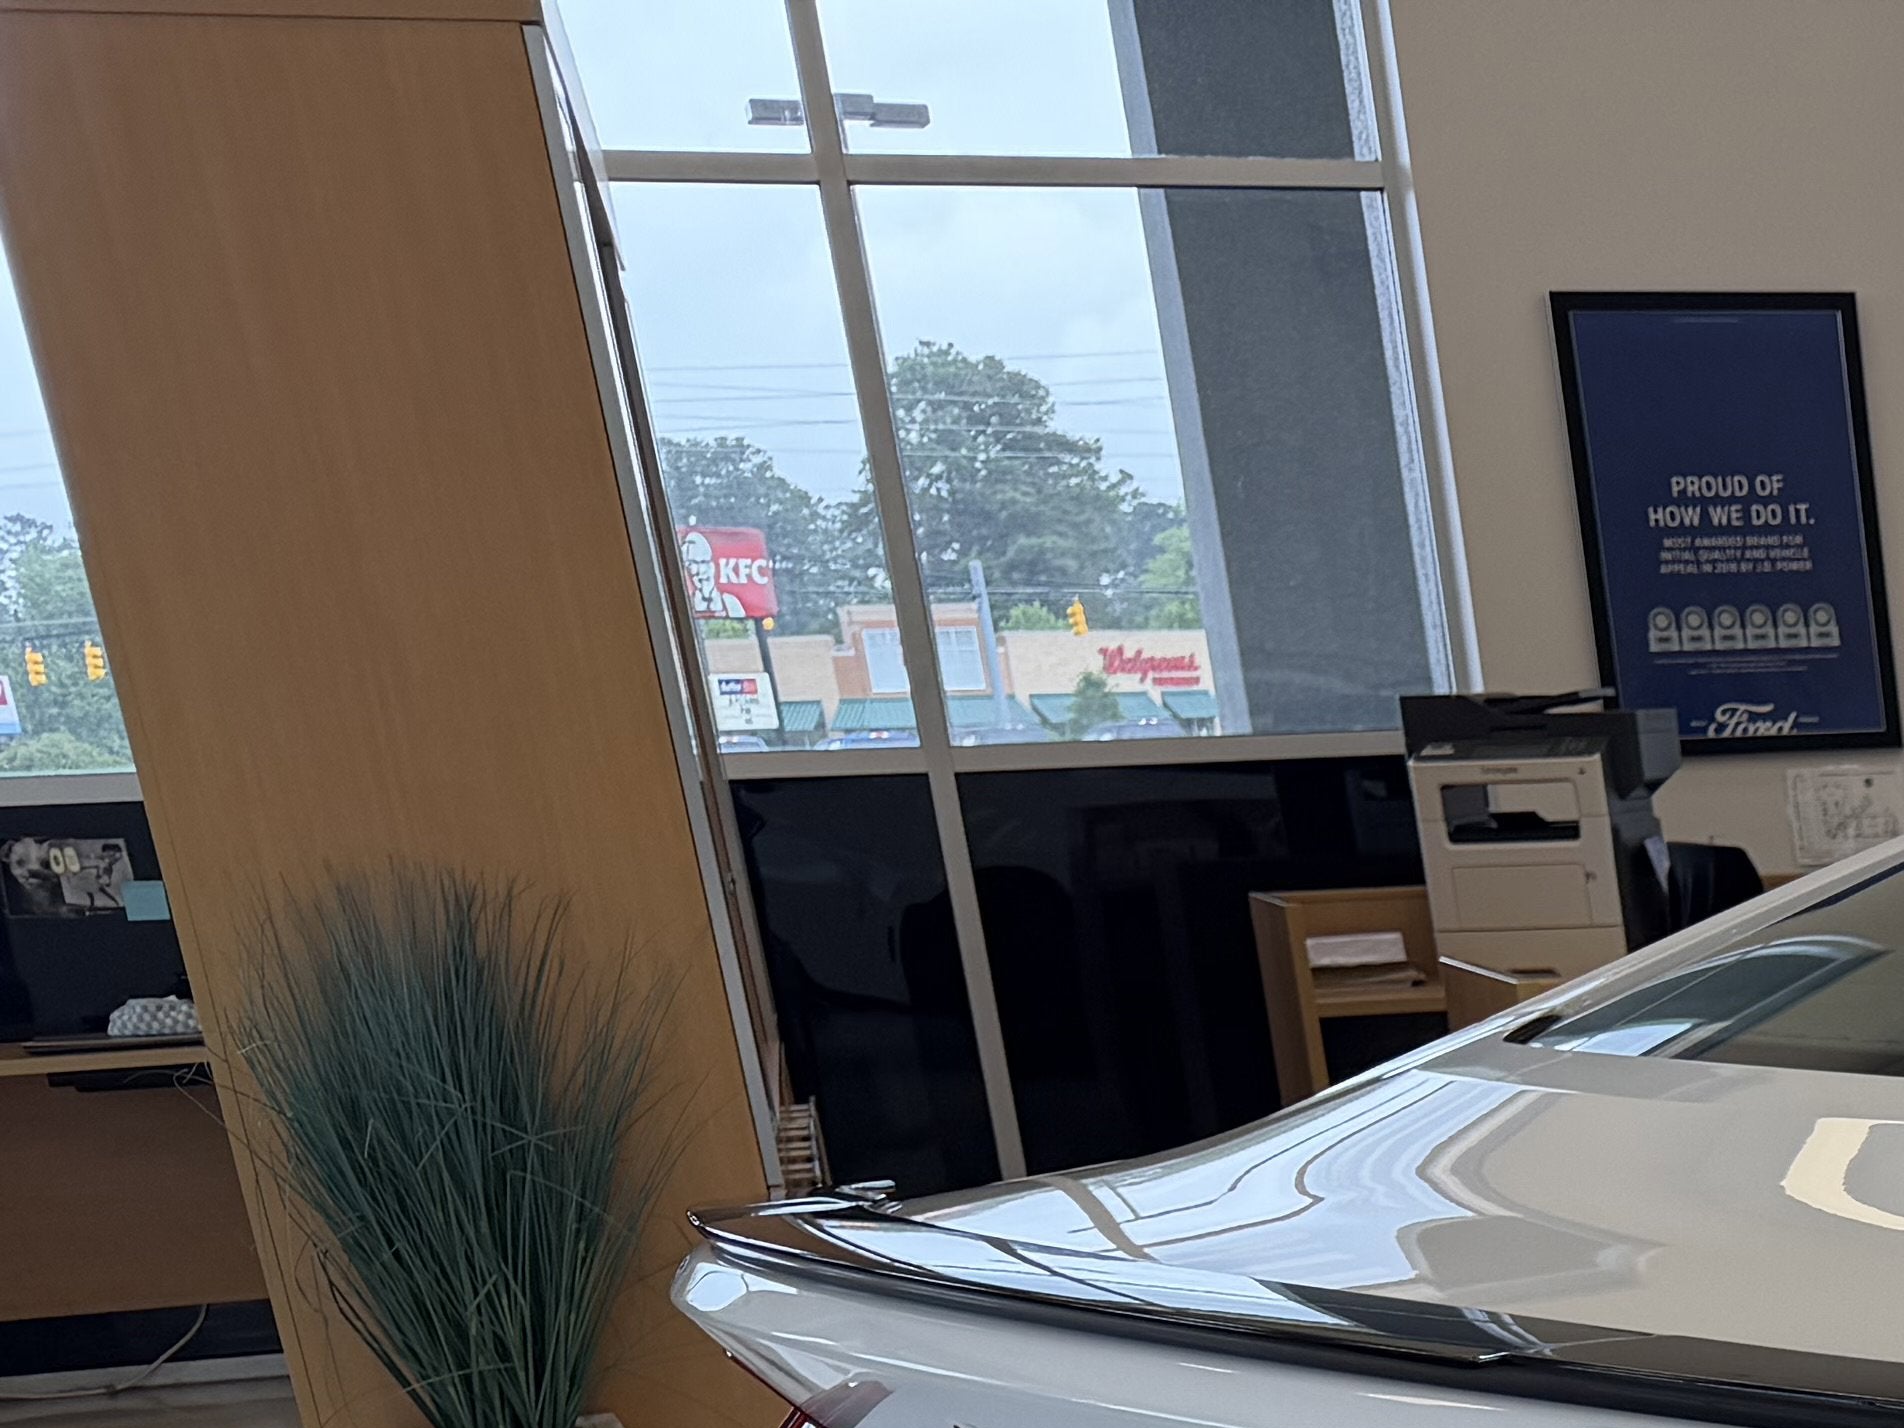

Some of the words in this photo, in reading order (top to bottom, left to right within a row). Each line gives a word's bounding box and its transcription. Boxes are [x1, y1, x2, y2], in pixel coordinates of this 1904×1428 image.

[1670, 475, 1749, 498] PROUD
[1754, 474, 1784, 497] OF
[1647, 504, 1701, 528] HOW
[1707, 503, 1744, 527] WE
[1750, 502, 1783, 526] DO
[1788, 502, 1816, 525] IT.
[719, 557, 769, 585] KFC
[1707, 702, 1798, 739] Ford
